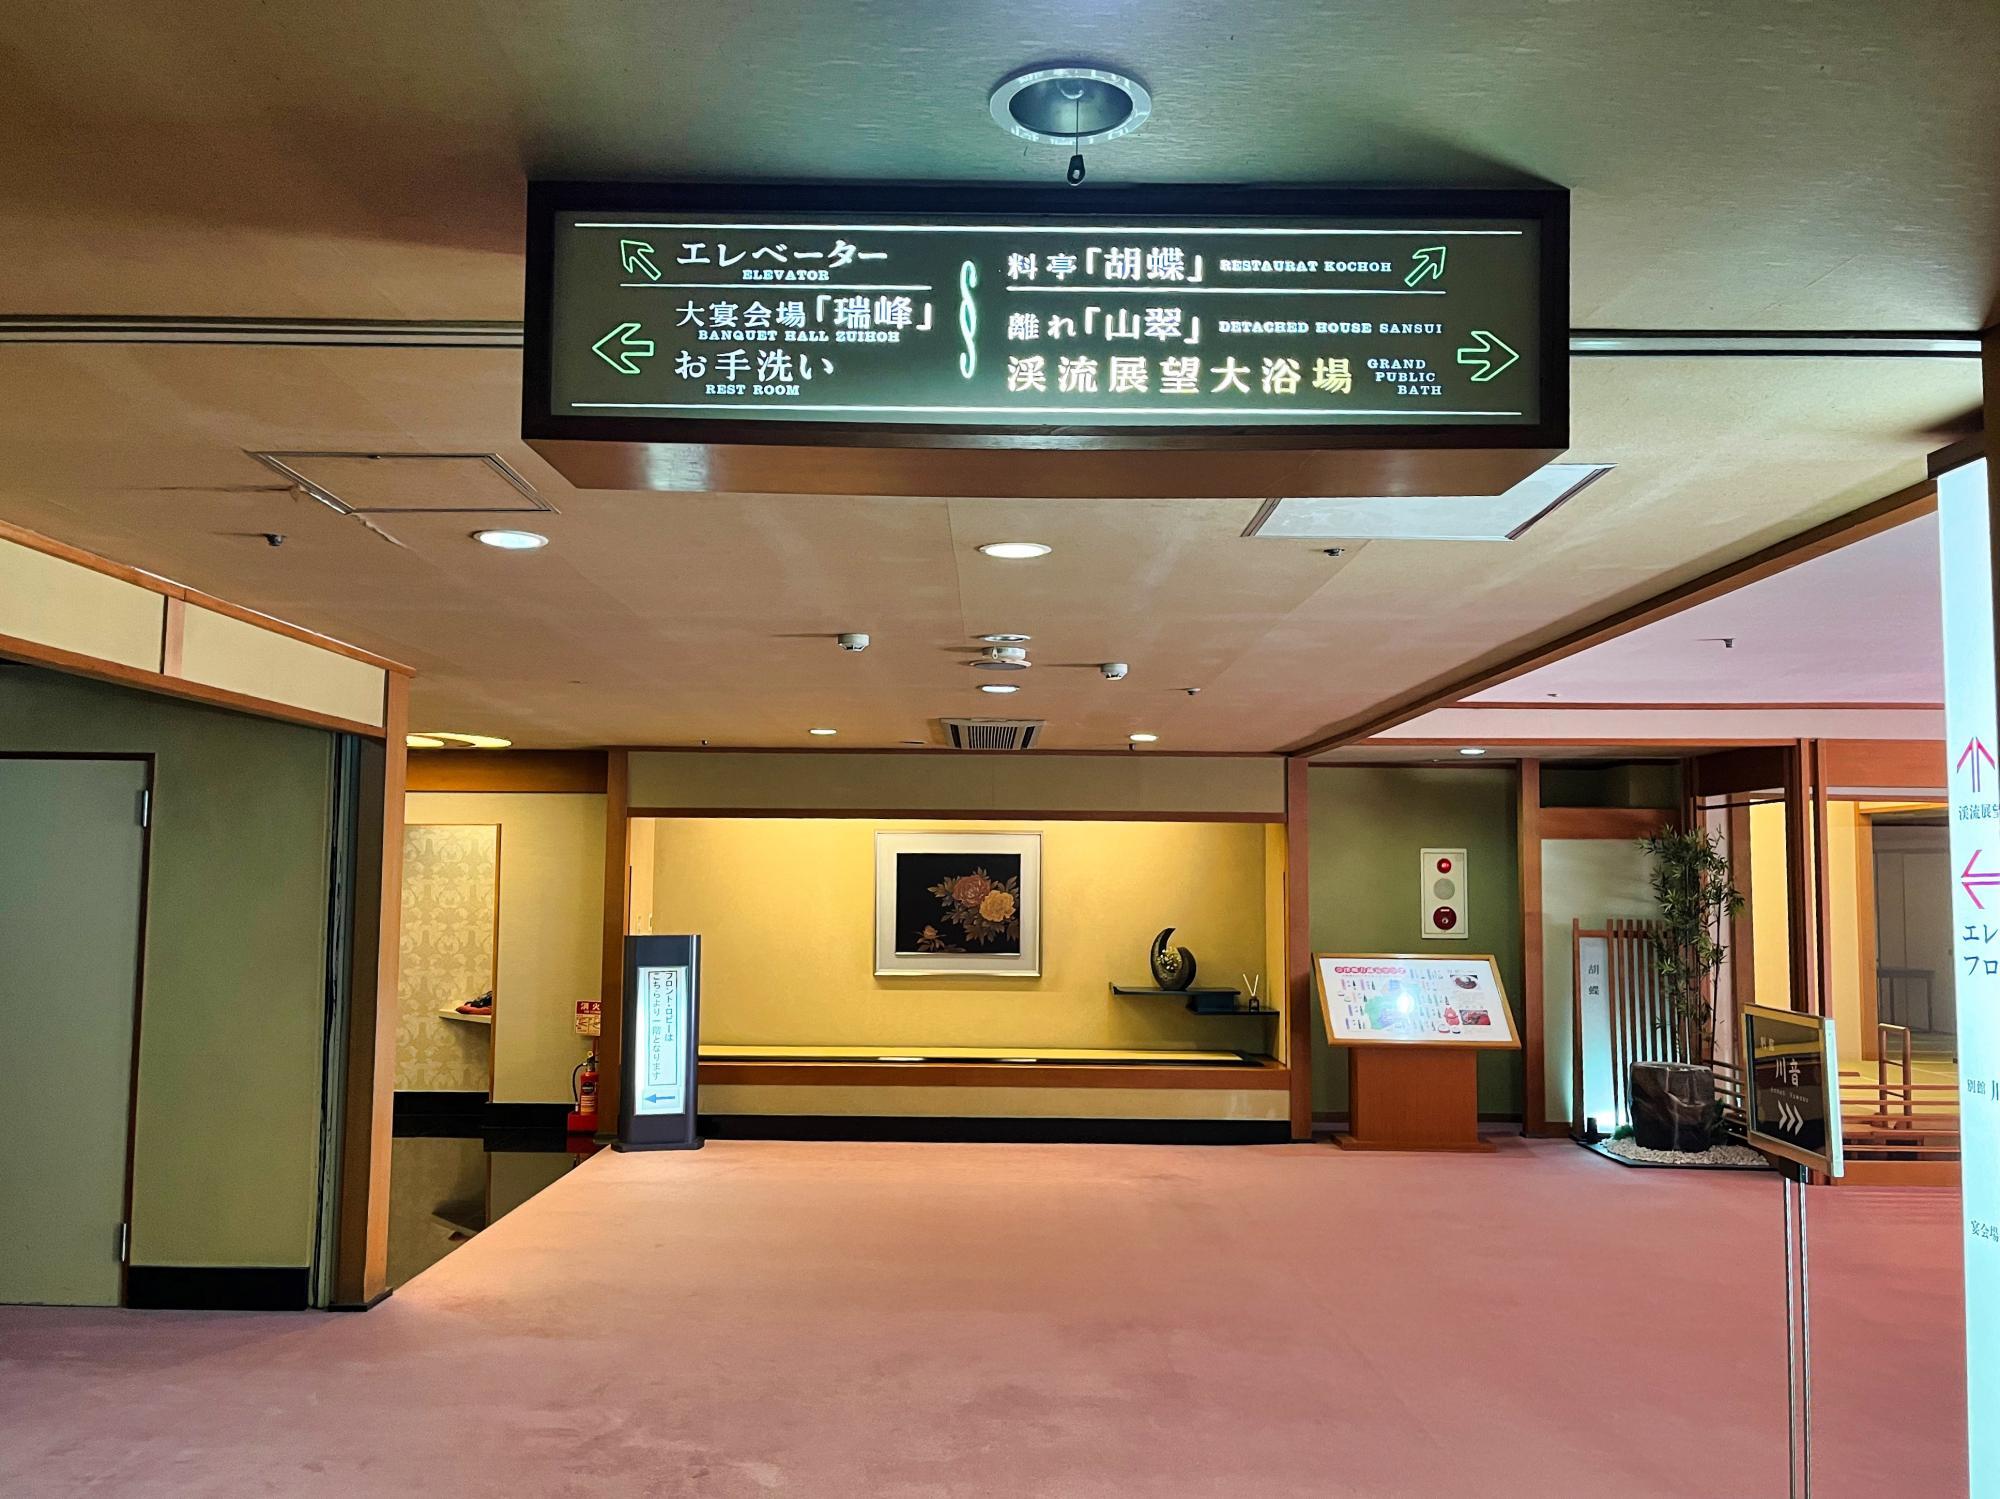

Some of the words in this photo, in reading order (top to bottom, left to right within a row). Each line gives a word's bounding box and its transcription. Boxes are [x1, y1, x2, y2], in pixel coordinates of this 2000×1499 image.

[676, 239, 888, 268] エレベーター
[1007, 247, 1203, 282] 料亭「胡蝶」
[1219, 259, 1318, 273] RESTAURAT
[1324, 261, 1392, 273] KOCHOH
[742, 269, 829, 281] ELEVATOR
[675, 295, 933, 331] 大宴会場「瑞峰」
[1007, 306, 1200, 344] 離れ「山翠」
[1218, 321, 1309, 333] DETACHED
[1315, 322, 1373, 333] HOUSE
[1379, 323, 1443, 334] SANSUI
[698, 330, 777, 342] BANQUET
[784, 330, 829, 342] HALL
[835, 331, 900, 343] ZUIHOH
[674, 348, 834, 382] お手洗い
[1367, 358, 1426, 370] GRAND
[1007, 355, 1352, 395] 渓流展望大浴場
[1375, 372, 1436, 383] PUBLIC
[705, 384, 746, 395] REST
[752, 384, 800, 395] ROOM
[1397, 385, 1442, 396] BATH
[1962, 924, 1999, 944] エレ
[1963, 956, 1999, 976] フロ
[1775, 1057, 1801, 1087] 川音
